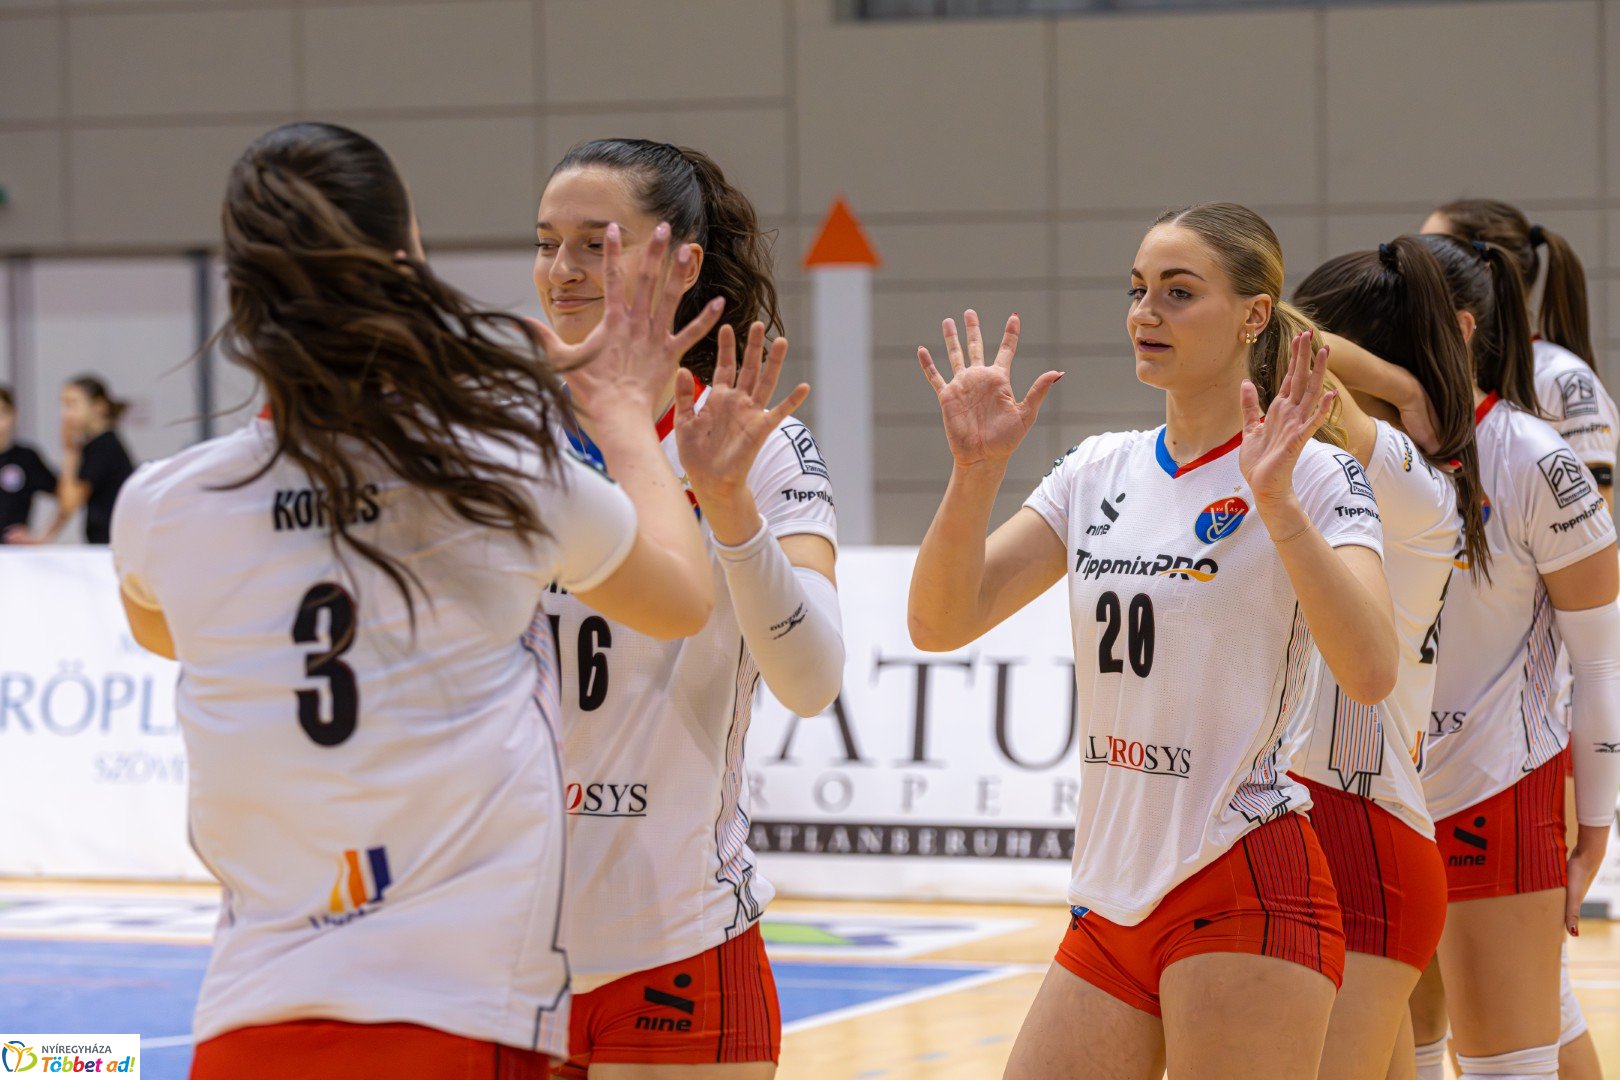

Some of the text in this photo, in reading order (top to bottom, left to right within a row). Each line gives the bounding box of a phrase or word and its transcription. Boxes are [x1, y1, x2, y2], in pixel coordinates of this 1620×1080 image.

[1076, 548, 1219, 583] TippmixPRO
[1096, 590, 1155, 679] 20
[292, 582, 359, 746] 3
[1449, 855, 1486, 867] nine
[635, 1015, 692, 1032] nine
